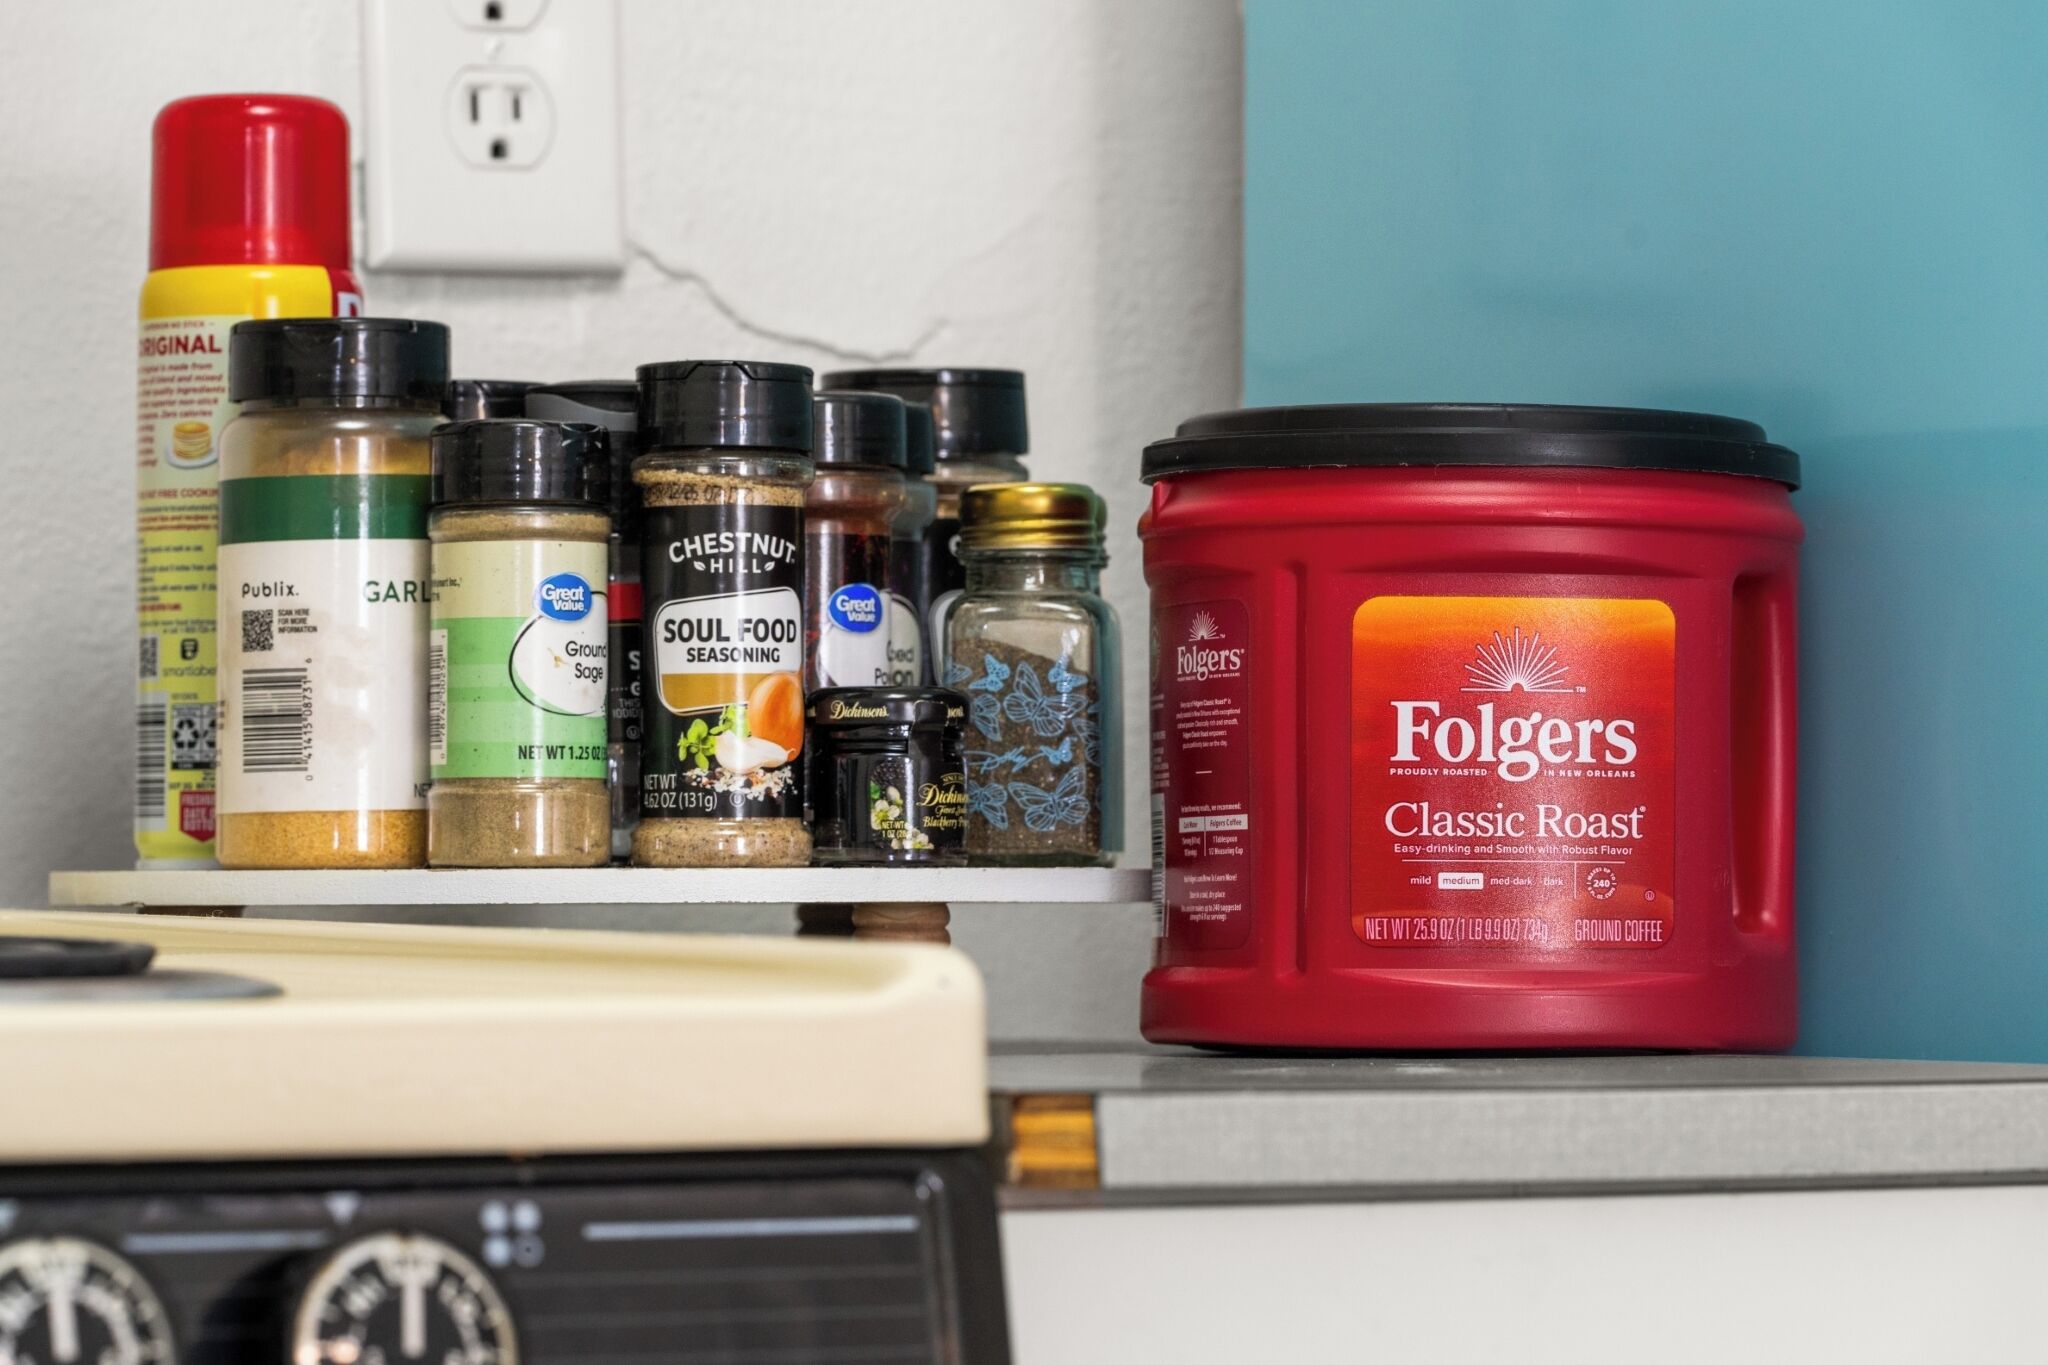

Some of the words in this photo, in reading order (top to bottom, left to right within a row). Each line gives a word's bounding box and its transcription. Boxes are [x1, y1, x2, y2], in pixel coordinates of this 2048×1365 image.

[669, 532, 796, 564] CHESTNUT
[710, 559, 761, 574] HILL
[541, 583, 585, 601] Great
[553, 599, 585, 611] Value
[836, 595, 876, 612] Great
[278, 609, 294, 617] SCAN
[295, 608, 310, 617] HERE
[847, 611, 876, 623] Value
[290, 617, 307, 625] MORE
[278, 626, 318, 634] INFORMATION
[664, 618, 730, 643] SOUL
[738, 618, 797, 643] FOOD
[686, 647, 780, 663] SEASONING
[574, 663, 603, 683] Sage
[1390, 701, 1638, 782] Folgers
[518, 745, 542, 761] NET
[546, 745, 566, 761] WT
[568, 745, 590, 761] 1.25
[591, 745, 601, 760] OZ
[644, 774, 658, 789] NET
[659, 773, 677, 789] WT
[1390, 768, 1439, 776] PROUDLY
[1442, 768, 1488, 776] ROASTED
[1545, 769, 1555, 777] IN
[1560, 769, 1583, 777] NEW
[1586, 770, 1636, 778] ORLEANS
[644, 793, 660, 808] 4.62
[660, 792, 677, 808] OZ
[679, 792, 718, 812] (131g)
[1385, 801, 1526, 838] Classic
[1394, 843, 1471, 855] Easy-drinking
[1473, 844, 1493, 854] and
[1496, 844, 1535, 855] Smooth
[1538, 845, 1559, 854] with
[1562, 845, 1598, 855] Robust
[1601, 846, 1633, 856] Flavor
[1410, 876, 1432, 886] mild
[1442, 877, 1480, 885] medium
[1544, 877, 1565, 886] dark
[1593, 879, 1611, 888] 240
[1365, 918, 1389, 940] NET
[1391, 918, 1412, 940] WT
[1414, 918, 1438, 941] 25.9
[1440, 918, 1454, 941] OZ
[1456, 917, 1466, 942] (1
[1469, 918, 1482, 941] LB
[1485, 918, 1501, 941] 9.9
[1503, 918, 1520, 943] OZ)
[1523, 919, 1549, 943] 734g
[1575, 919, 1621, 942] GROUND
[1625, 919, 1663, 942] COFFEE
